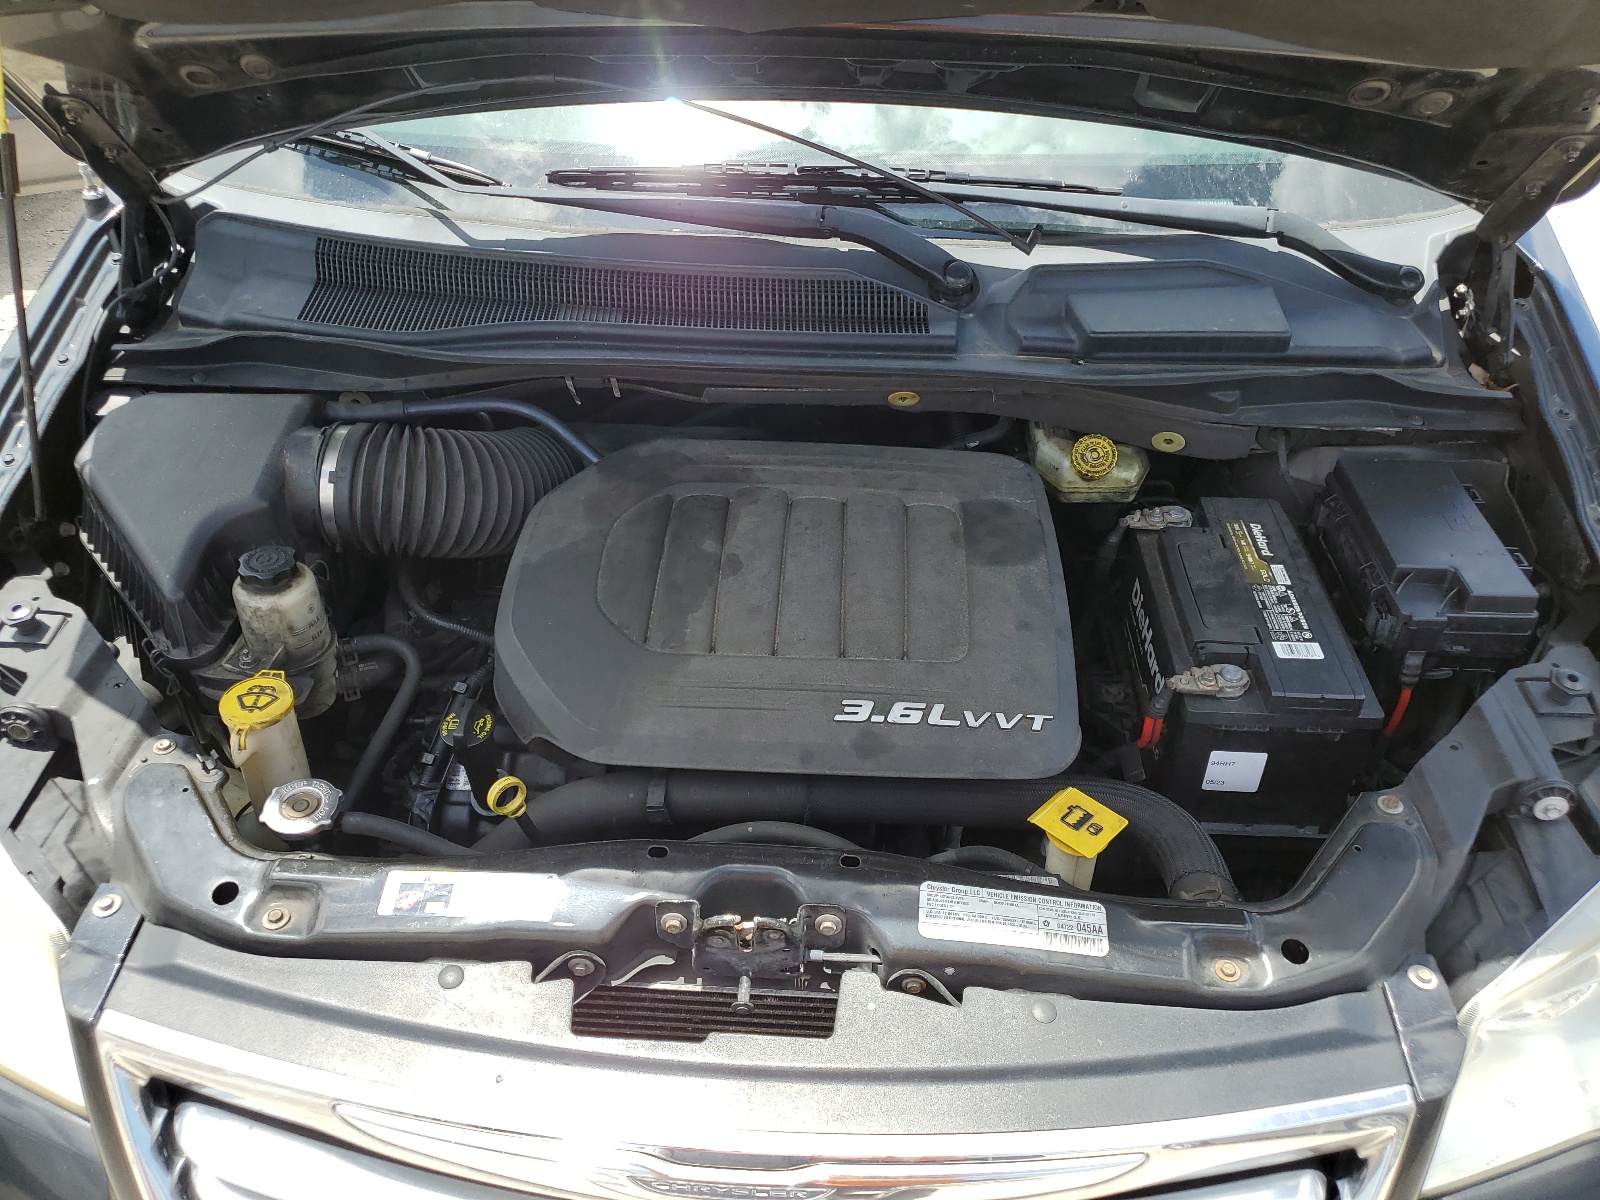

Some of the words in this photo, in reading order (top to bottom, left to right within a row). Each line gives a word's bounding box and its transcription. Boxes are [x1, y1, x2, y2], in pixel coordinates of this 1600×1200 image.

[1249, 524, 1274, 556] DieHard
[1132, 576, 1165, 695] DieHard
[282, 781, 308, 793] KEEP
[926, 883, 950, 892] Chrysler
[951, 886, 968, 895] Group
[986, 891, 1009, 899] VEHICLE
[1010, 894, 1036, 902] EMISSION
[1038, 897, 1063, 906] CONTROL
[1065, 900, 1102, 911] INFORMATION
[1076, 923, 1103, 934] 045AA
[651, 1181, 808, 1198] CHRYSLER
